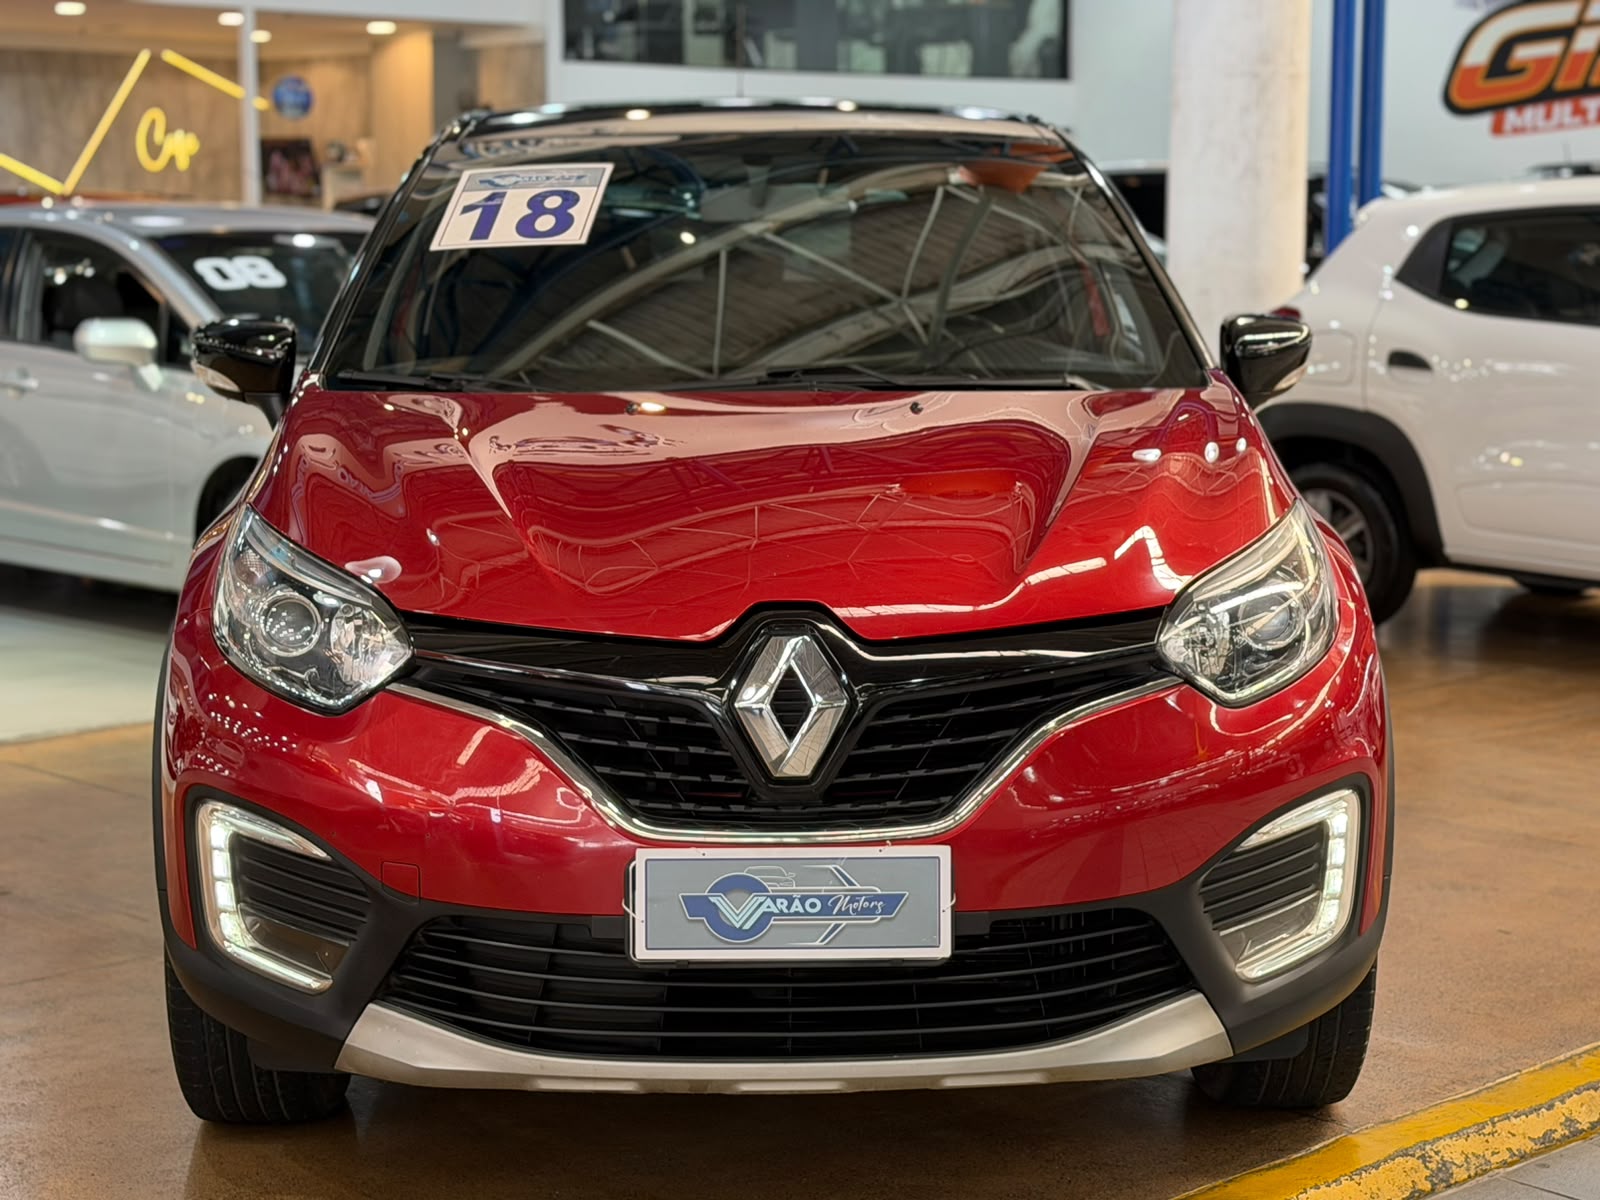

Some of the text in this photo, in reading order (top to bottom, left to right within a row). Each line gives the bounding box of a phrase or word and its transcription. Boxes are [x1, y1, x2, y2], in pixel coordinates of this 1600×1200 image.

[459, 189, 581, 241] 18
[193, 255, 287, 291] 08
[708, 894, 886, 930] VARÃO Motors
